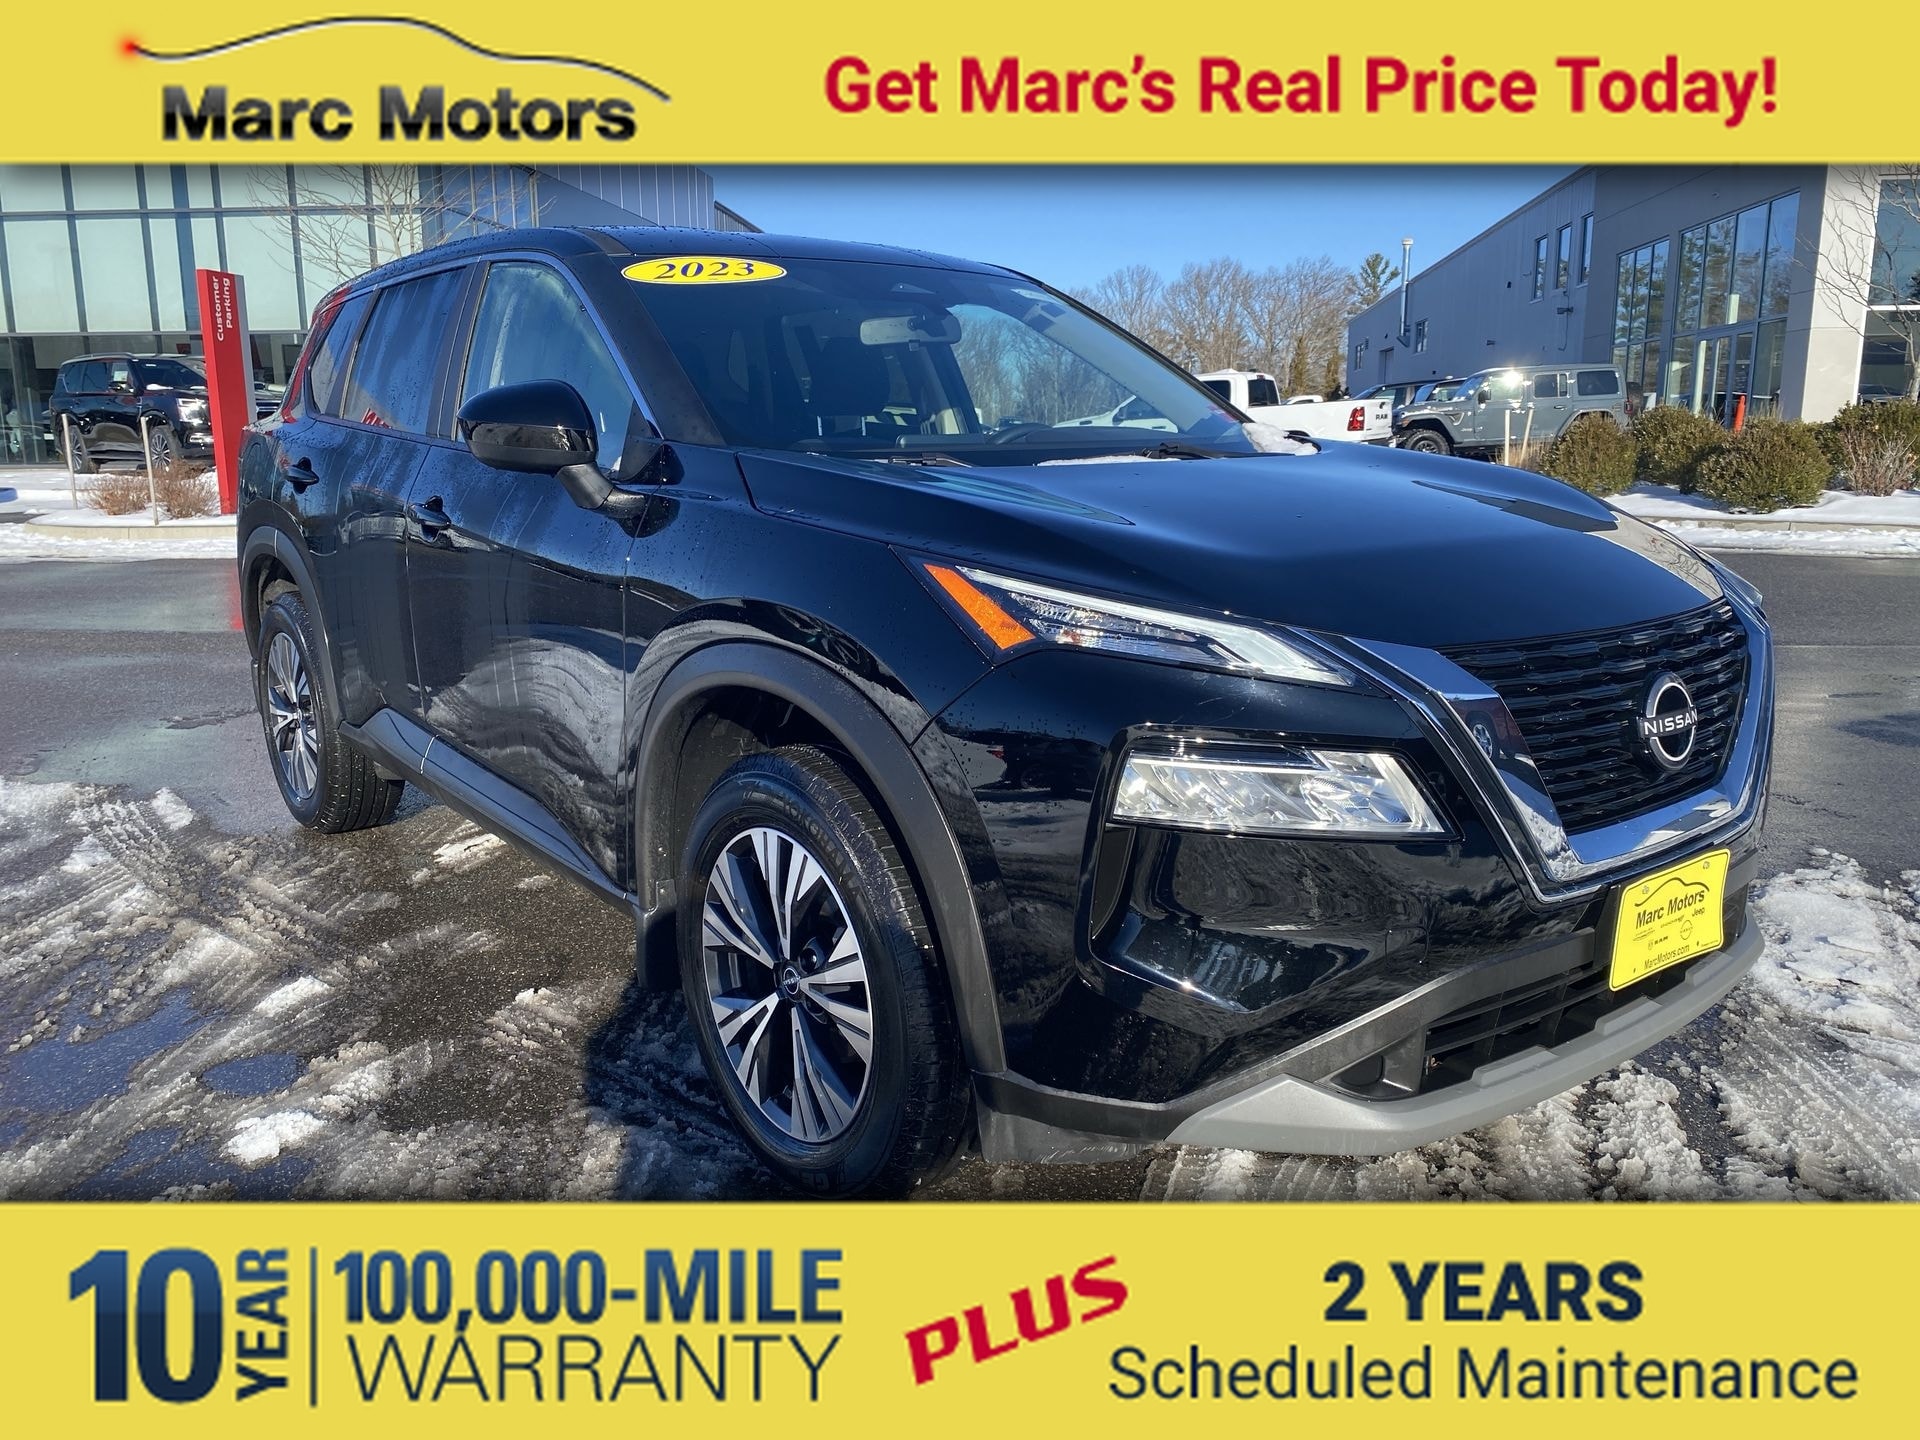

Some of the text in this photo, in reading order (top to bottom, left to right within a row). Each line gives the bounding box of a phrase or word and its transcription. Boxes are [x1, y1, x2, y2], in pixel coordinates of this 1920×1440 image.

[653, 261, 755, 280] 2023
[212, 276, 224, 341] Customer
[222, 278, 233, 329] Parking
[1643, 708, 1698, 735] NISSAN
[1635, 904, 1665, 930] Marc
[1666, 889, 1705, 916] Motors
[1643, 944, 1690, 970] MarcMotors.com
